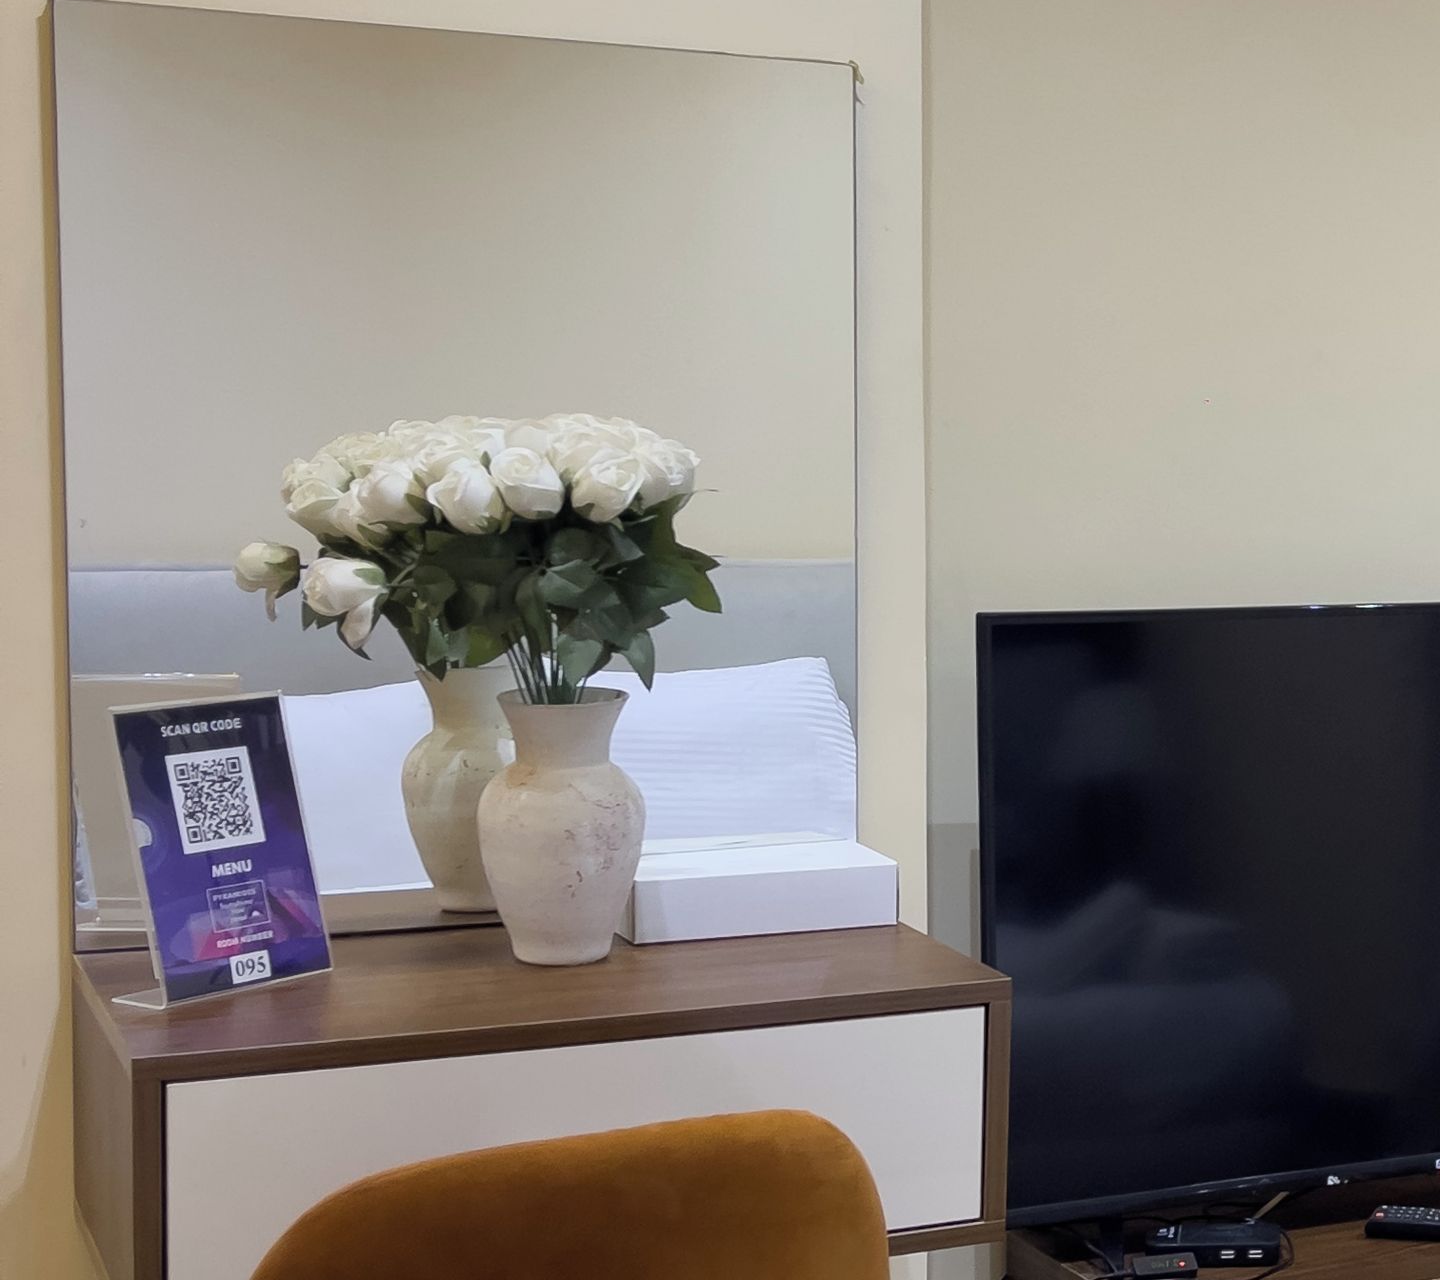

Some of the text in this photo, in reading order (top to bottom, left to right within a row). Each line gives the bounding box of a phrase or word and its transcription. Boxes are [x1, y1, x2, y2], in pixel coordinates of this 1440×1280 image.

[160, 717, 242, 738] SCAN QR CODE
[211, 859, 252, 878] MENU
[235, 956, 266, 977] 095
